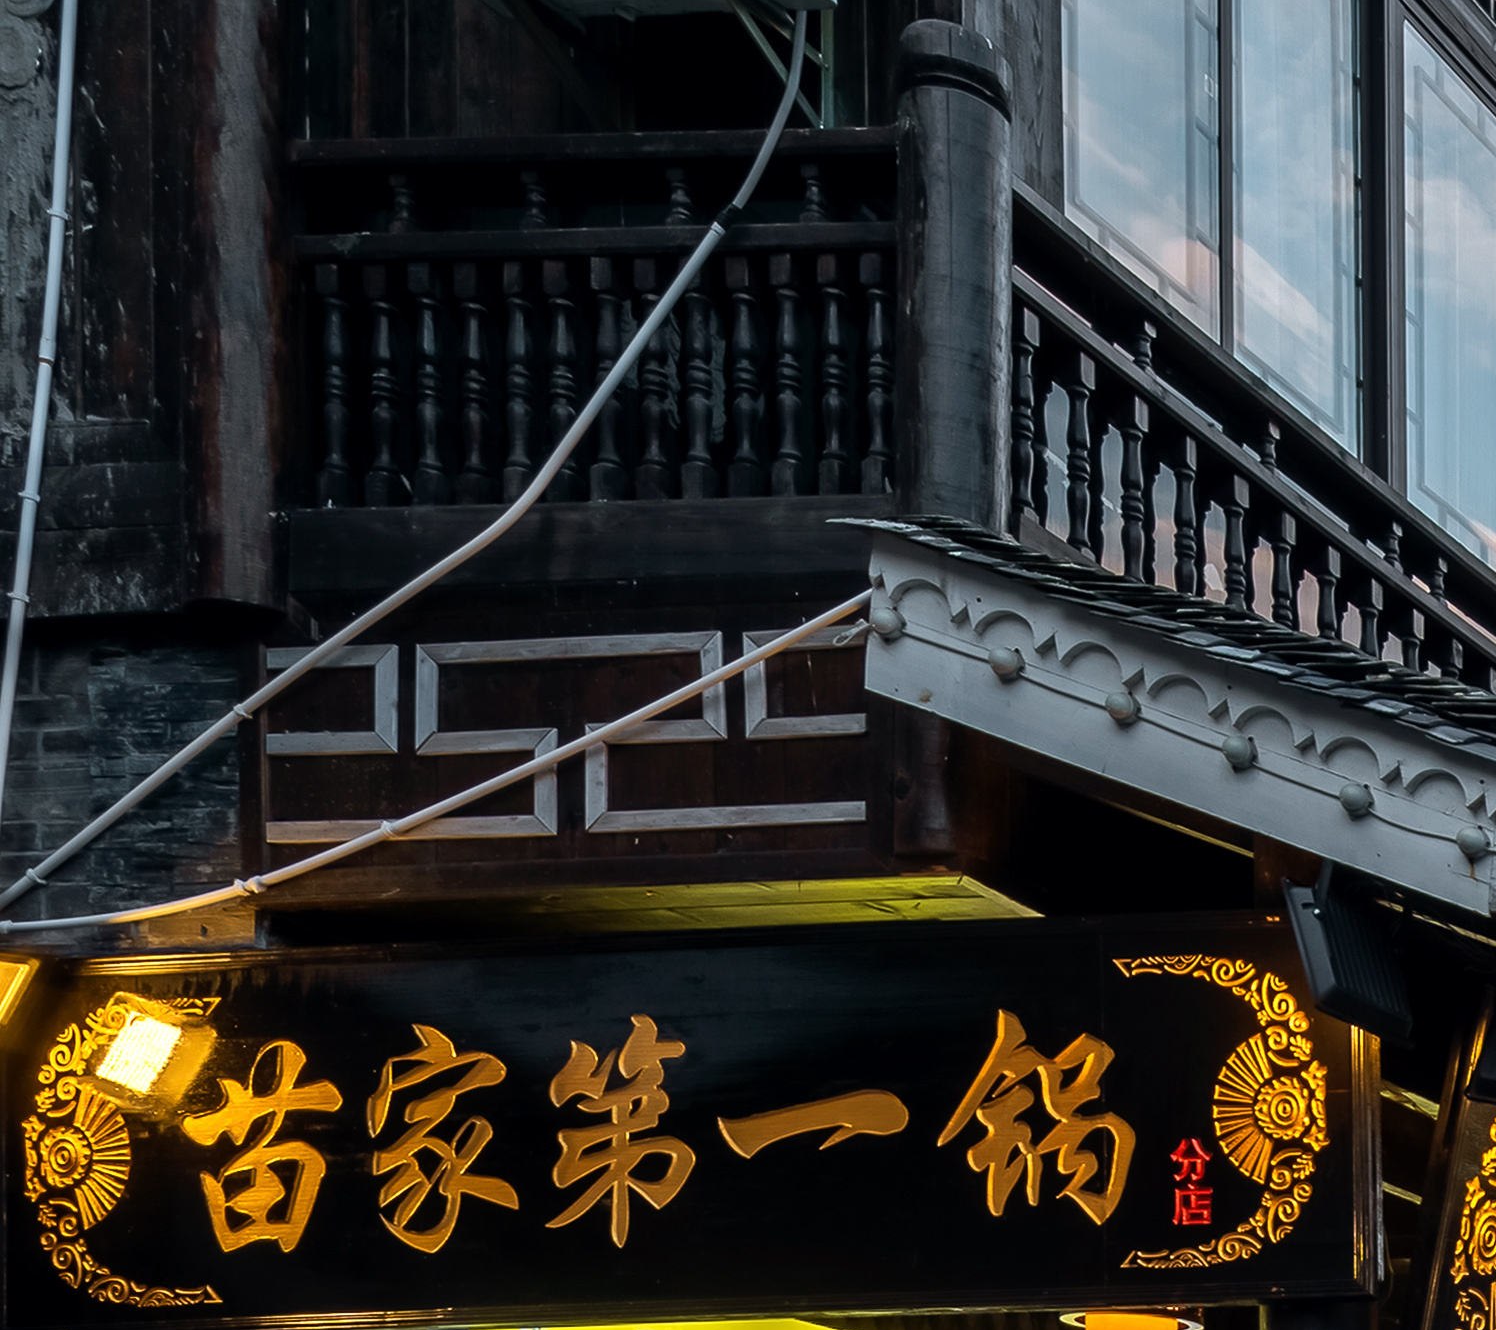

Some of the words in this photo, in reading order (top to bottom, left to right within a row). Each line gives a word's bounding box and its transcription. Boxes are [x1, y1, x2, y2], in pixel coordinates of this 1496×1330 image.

[183, 1007, 1135, 1253] 苗家第一锅
[1170, 1138, 1213, 1227] 分店
